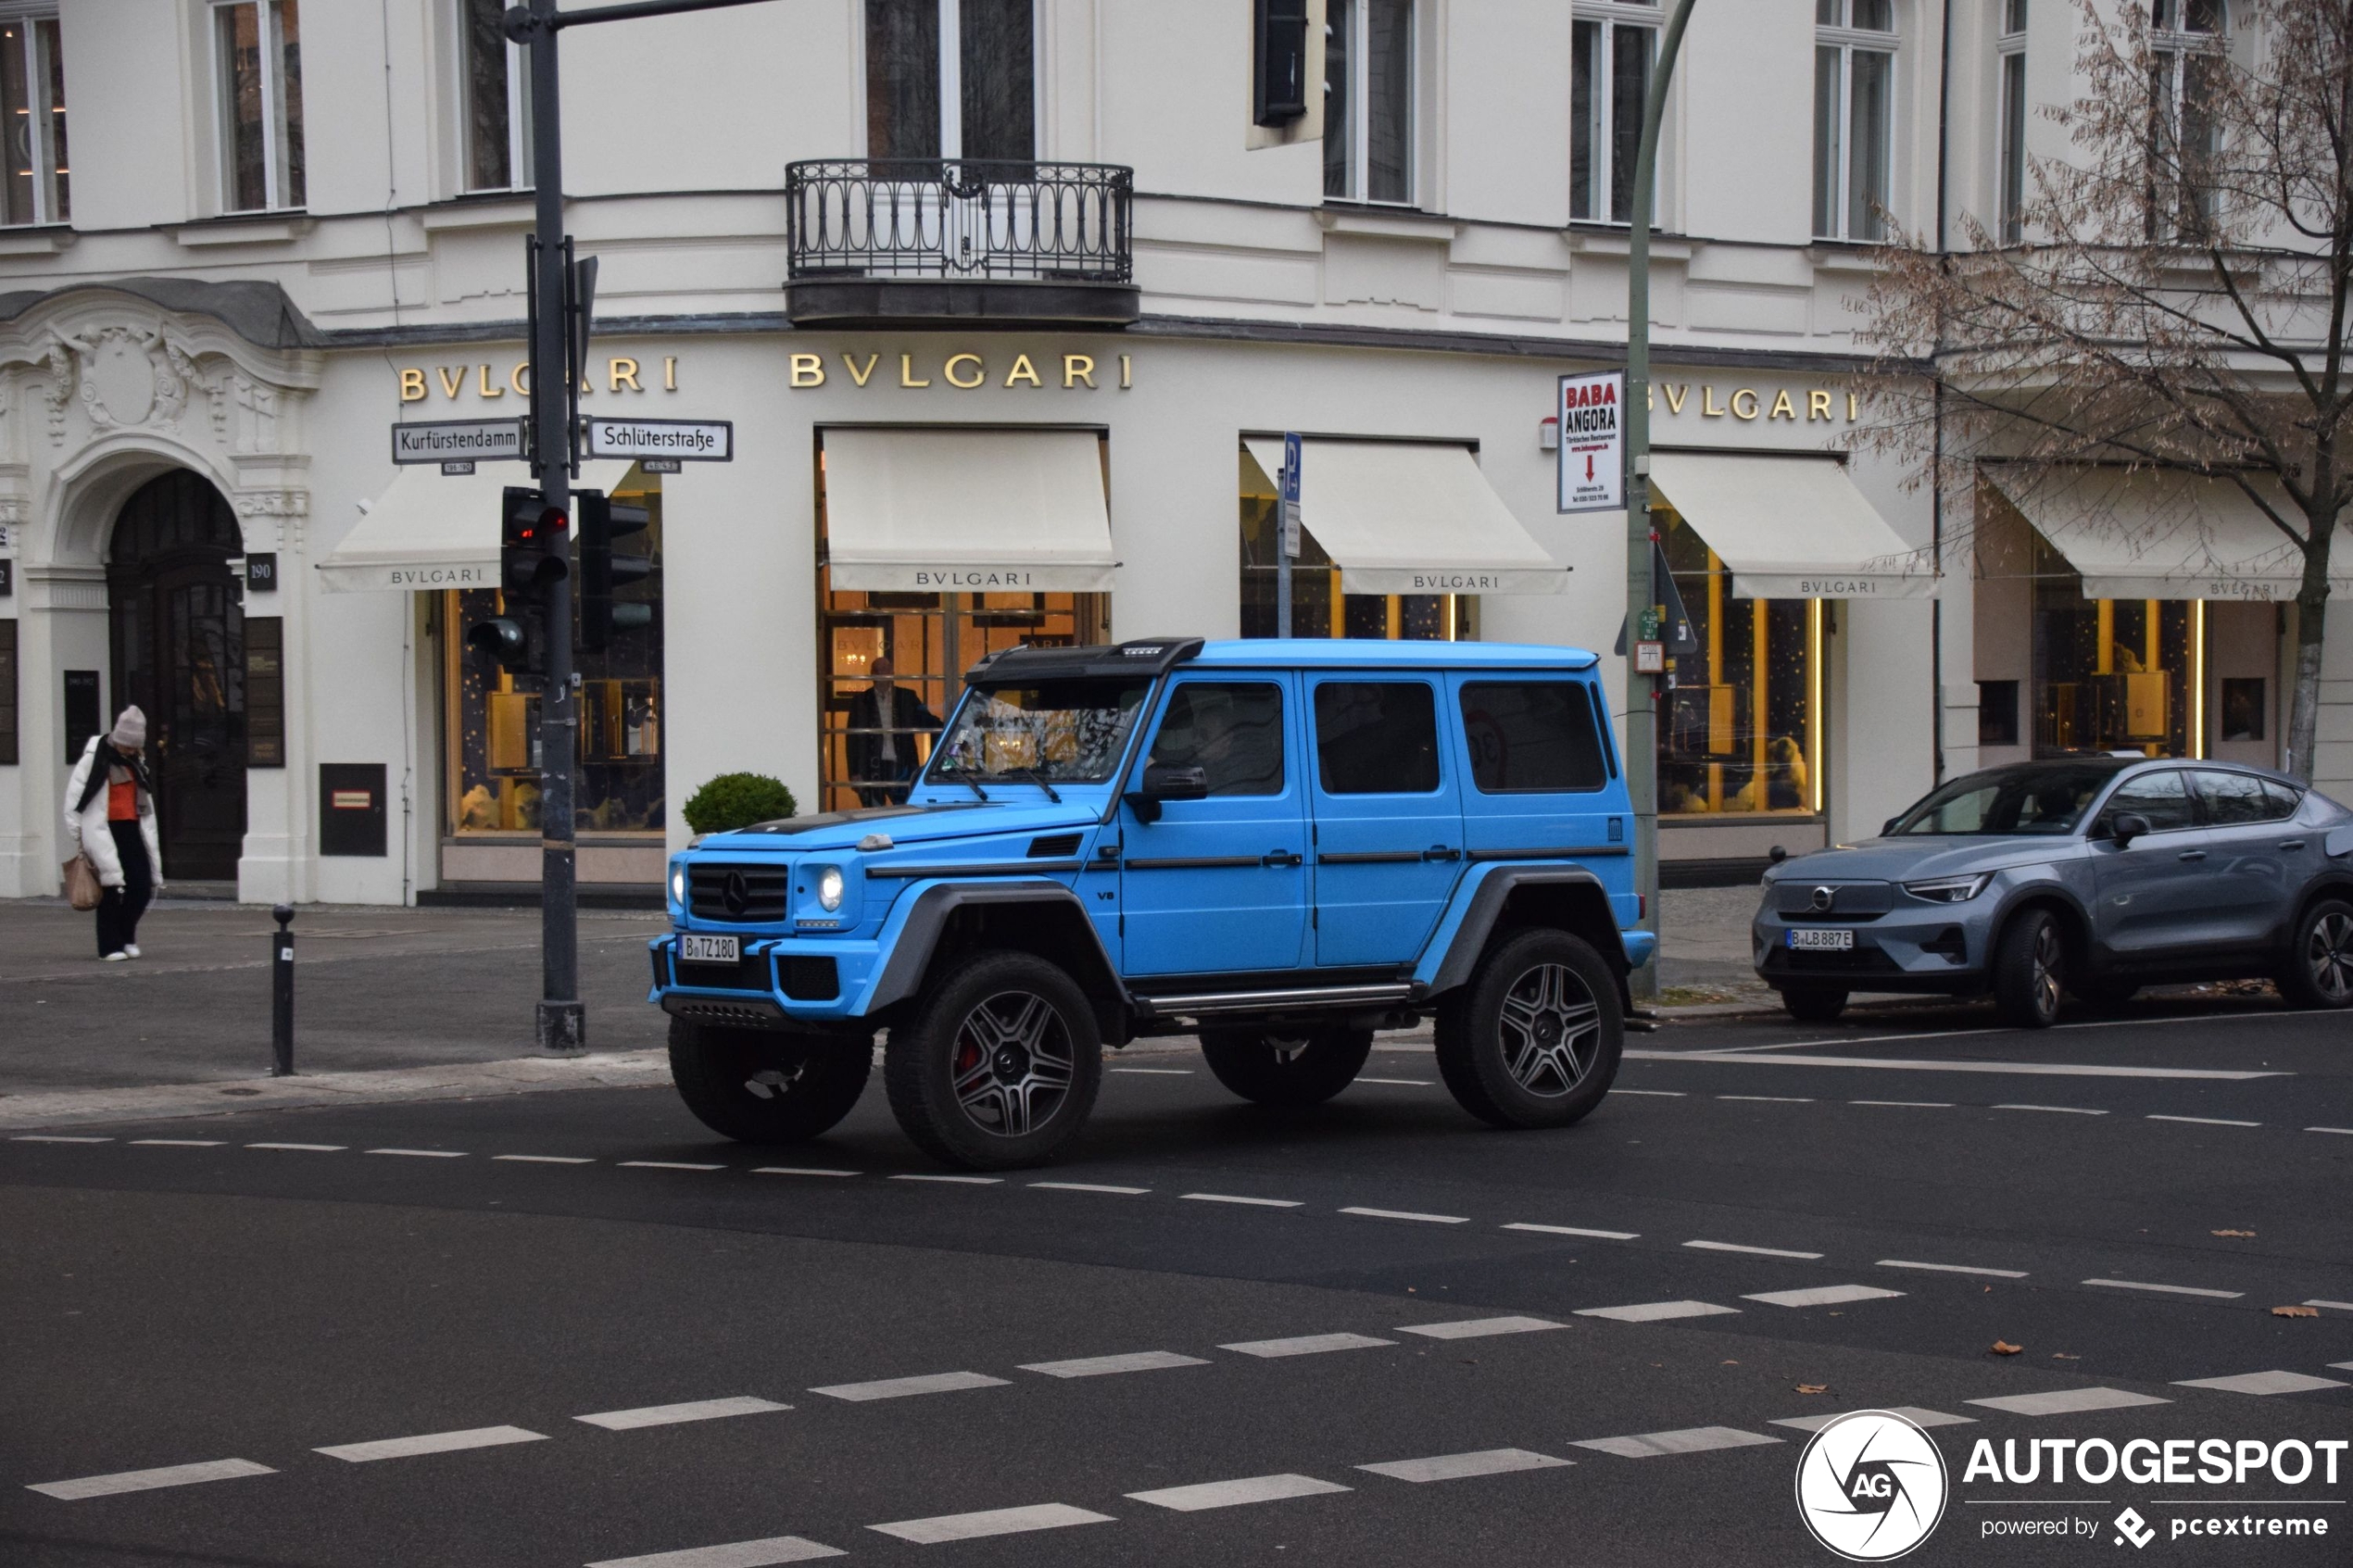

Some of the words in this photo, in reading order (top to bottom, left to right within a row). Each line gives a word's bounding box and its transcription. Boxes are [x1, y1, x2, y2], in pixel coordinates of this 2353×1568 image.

[788, 353, 1134, 389] BVLGARI
[1567, 383, 1616, 408] BABA
[1647, 383, 1857, 422] VLGARI
[1567, 408, 1616, 433] ANGORA
[400, 429, 517, 451] Kurfürstendamm
[604, 426, 714, 452] Schlüterstraße
[251, 564, 271, 579] 190
[392, 569, 482, 584] BVLGARI
[916, 572, 1030, 585] BVLGARI
[1414, 576, 1498, 588] BVLGARI
[1801, 582, 1876, 594] BVLGARI
[2210, 583, 2278, 595] BVLGARI
[1097, 891, 1114, 900] V8
[1793, 932, 1799, 945] B
[686, 937, 693, 957] B
